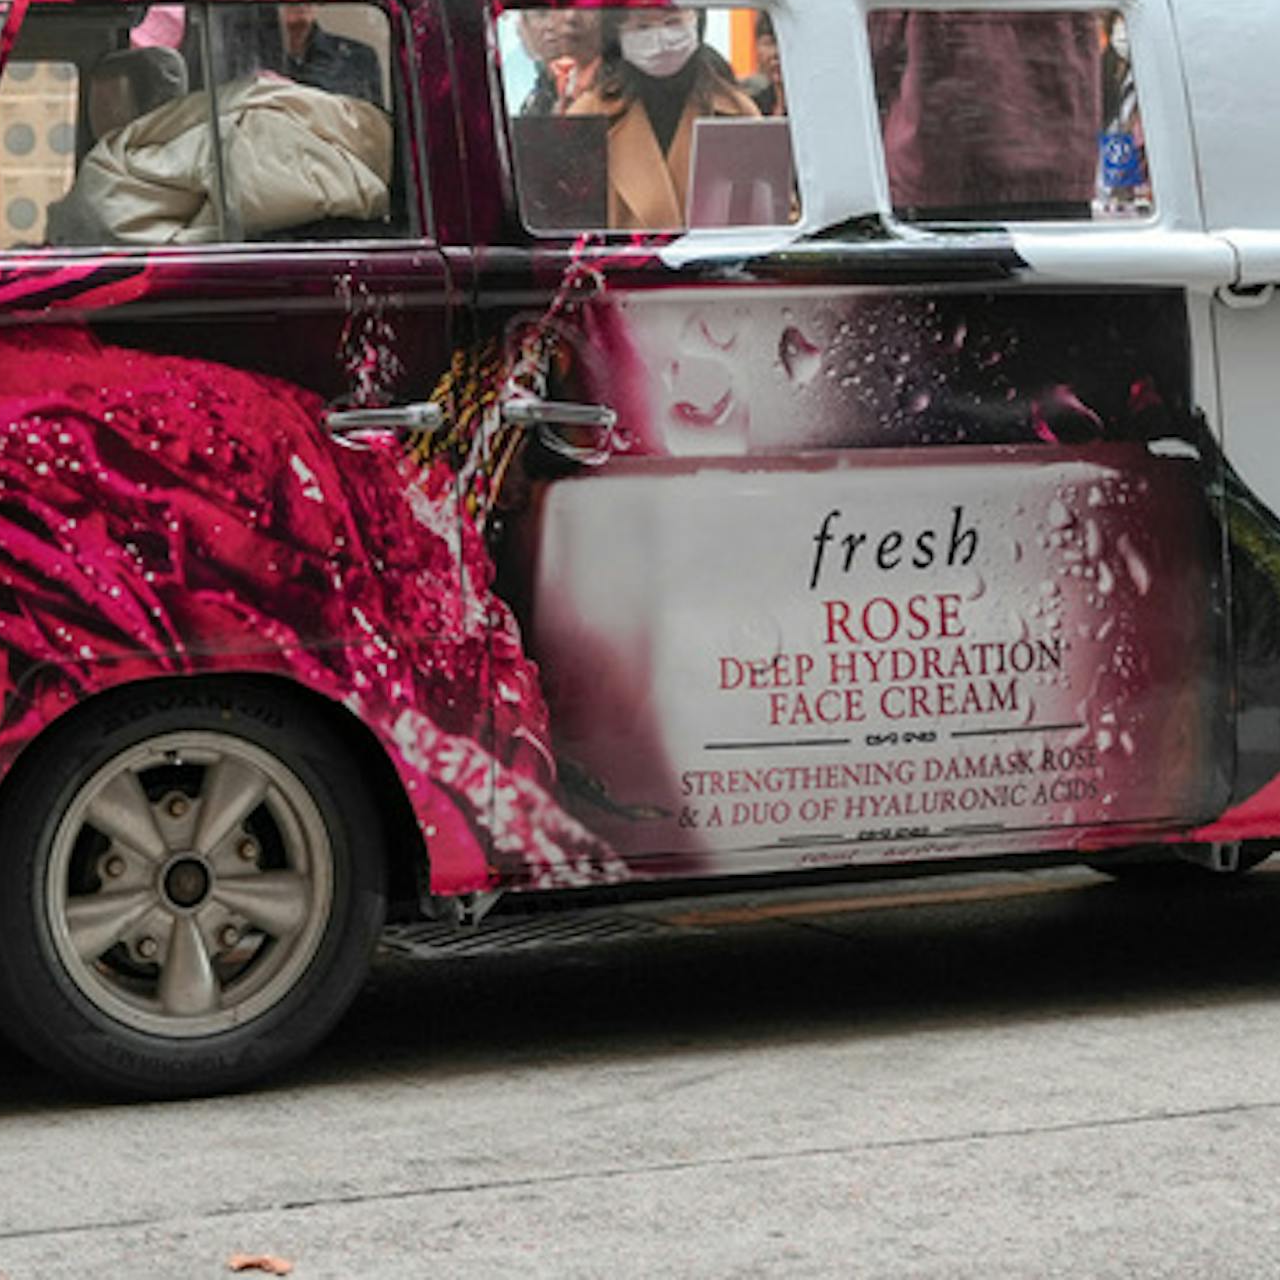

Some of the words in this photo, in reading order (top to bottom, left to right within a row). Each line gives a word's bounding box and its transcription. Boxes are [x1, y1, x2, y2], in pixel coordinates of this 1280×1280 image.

[809, 506, 979, 590] fresh
[822, 593, 967, 645] ROSE
[719, 656, 814, 691] DEEP
[829, 639, 1064, 686] HYDRATION
[769, 691, 867, 726] FACE
[880, 681, 1020, 721] CREAM
[680, 761, 916, 798] STRENGTHENING
[924, 751, 1035, 782] DAMASK
[1041, 746, 1098, 772] ROSE
[678, 806, 699, 828] &
[706, 804, 723, 827] A
[731, 800, 790, 826] DUO
[798, 796, 837, 823] OF
[844, 787, 1027, 818] HYALURONIC
[1032, 780, 1099, 804] ACIDS
